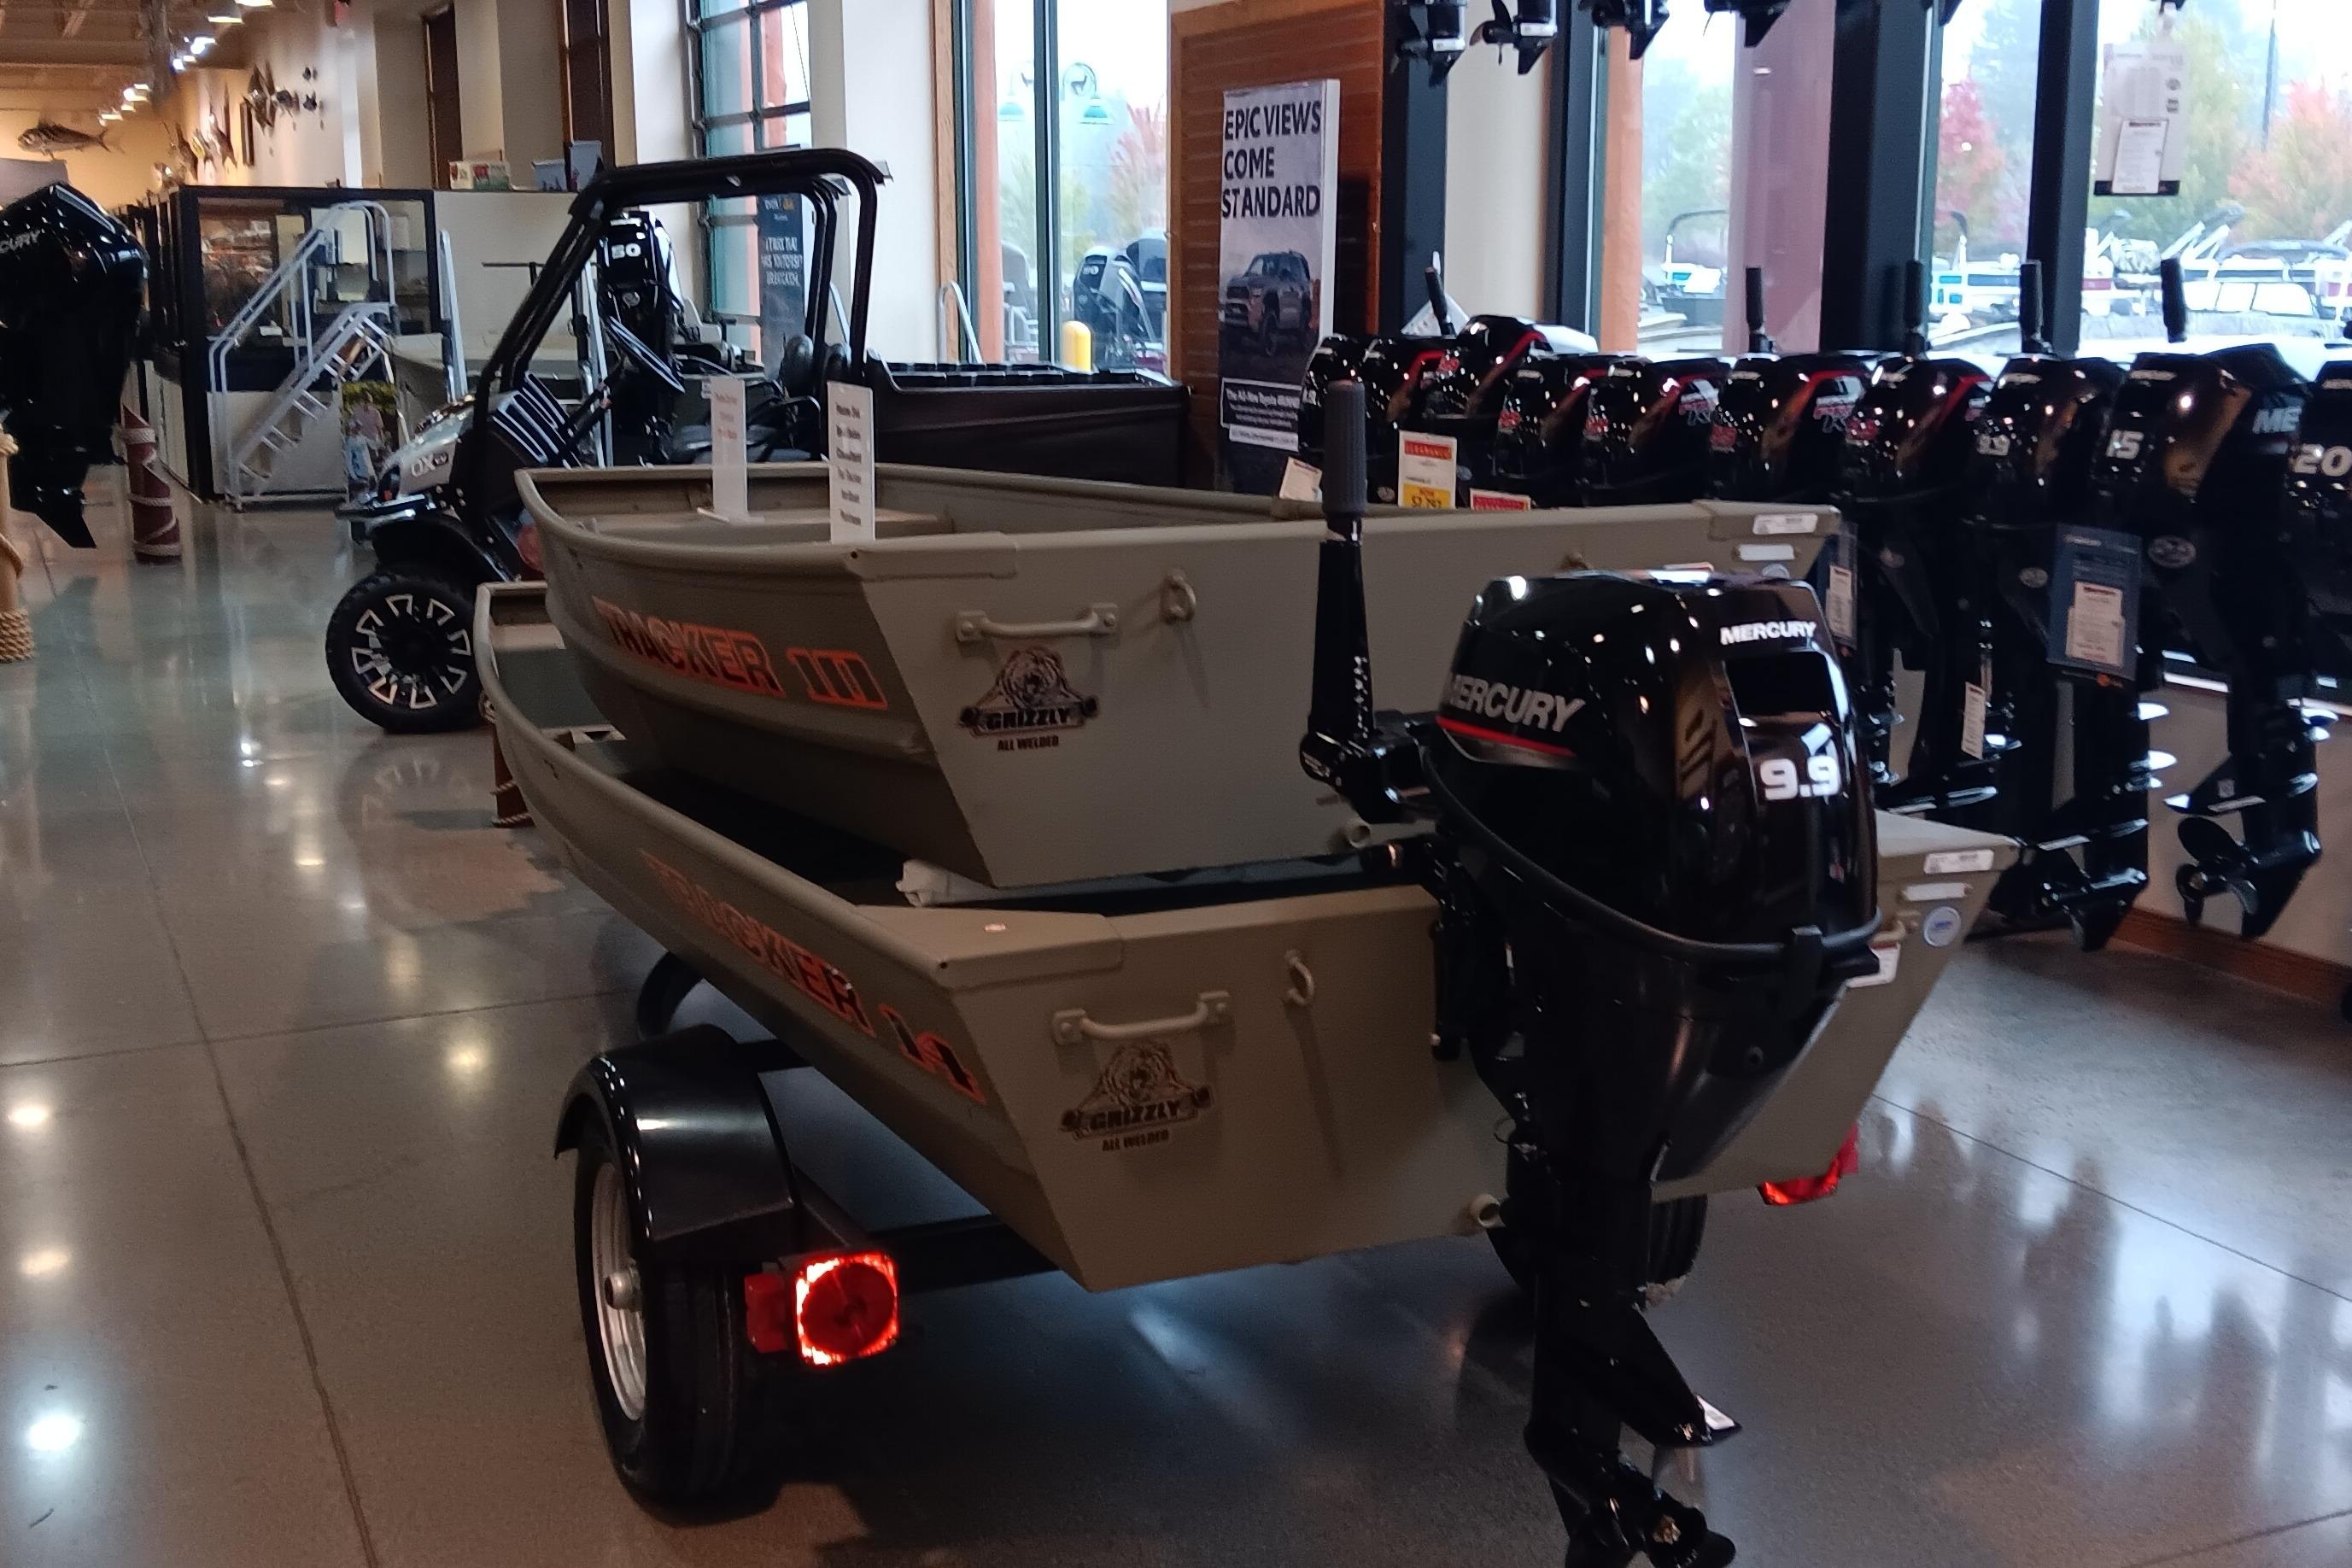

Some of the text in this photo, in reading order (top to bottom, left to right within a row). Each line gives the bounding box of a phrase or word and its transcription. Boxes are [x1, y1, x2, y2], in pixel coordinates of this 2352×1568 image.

[1225, 101, 1321, 140] EPIC VIEWS
[1224, 147, 1275, 180] COME
[1221, 185, 1320, 219] STANDARD
[592, 595, 787, 699] TRACKER
[1720, 620, 1817, 646] MERCURY
[1450, 674, 1586, 733] ERCURY
[997, 738, 1015, 752] ALL
[1759, 755, 1843, 801] 9.9
